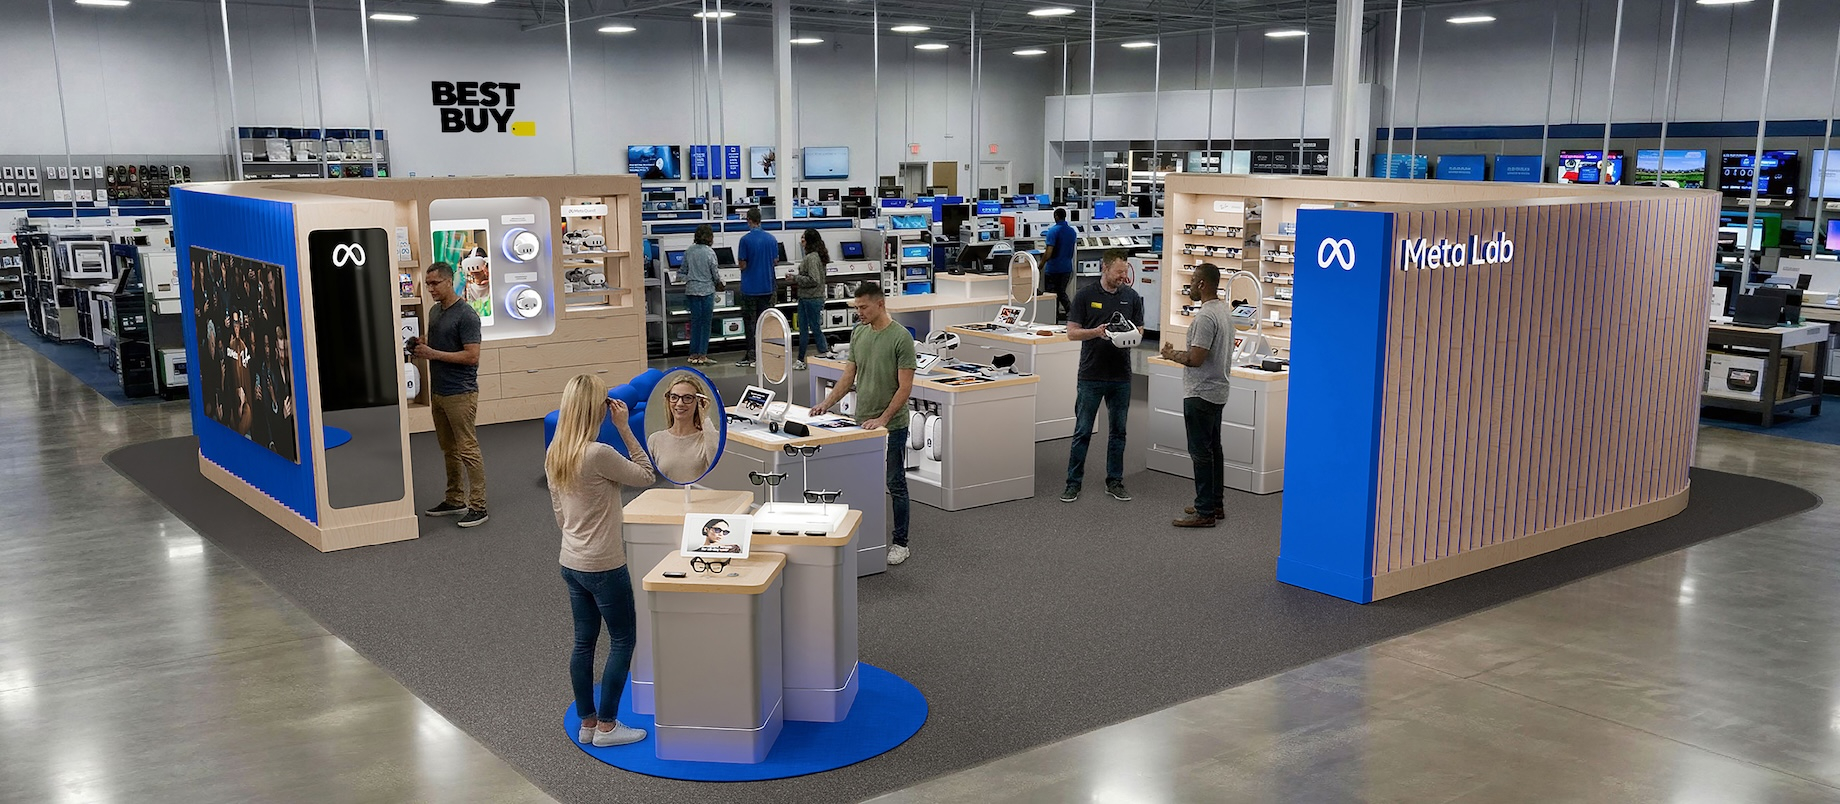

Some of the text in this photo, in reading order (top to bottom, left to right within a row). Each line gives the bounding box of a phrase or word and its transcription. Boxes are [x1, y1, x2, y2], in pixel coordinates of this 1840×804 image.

[431, 81, 520, 107] BEST
[440, 108, 515, 133] BUY
[1402, 231, 1514, 271] Meta Lab
